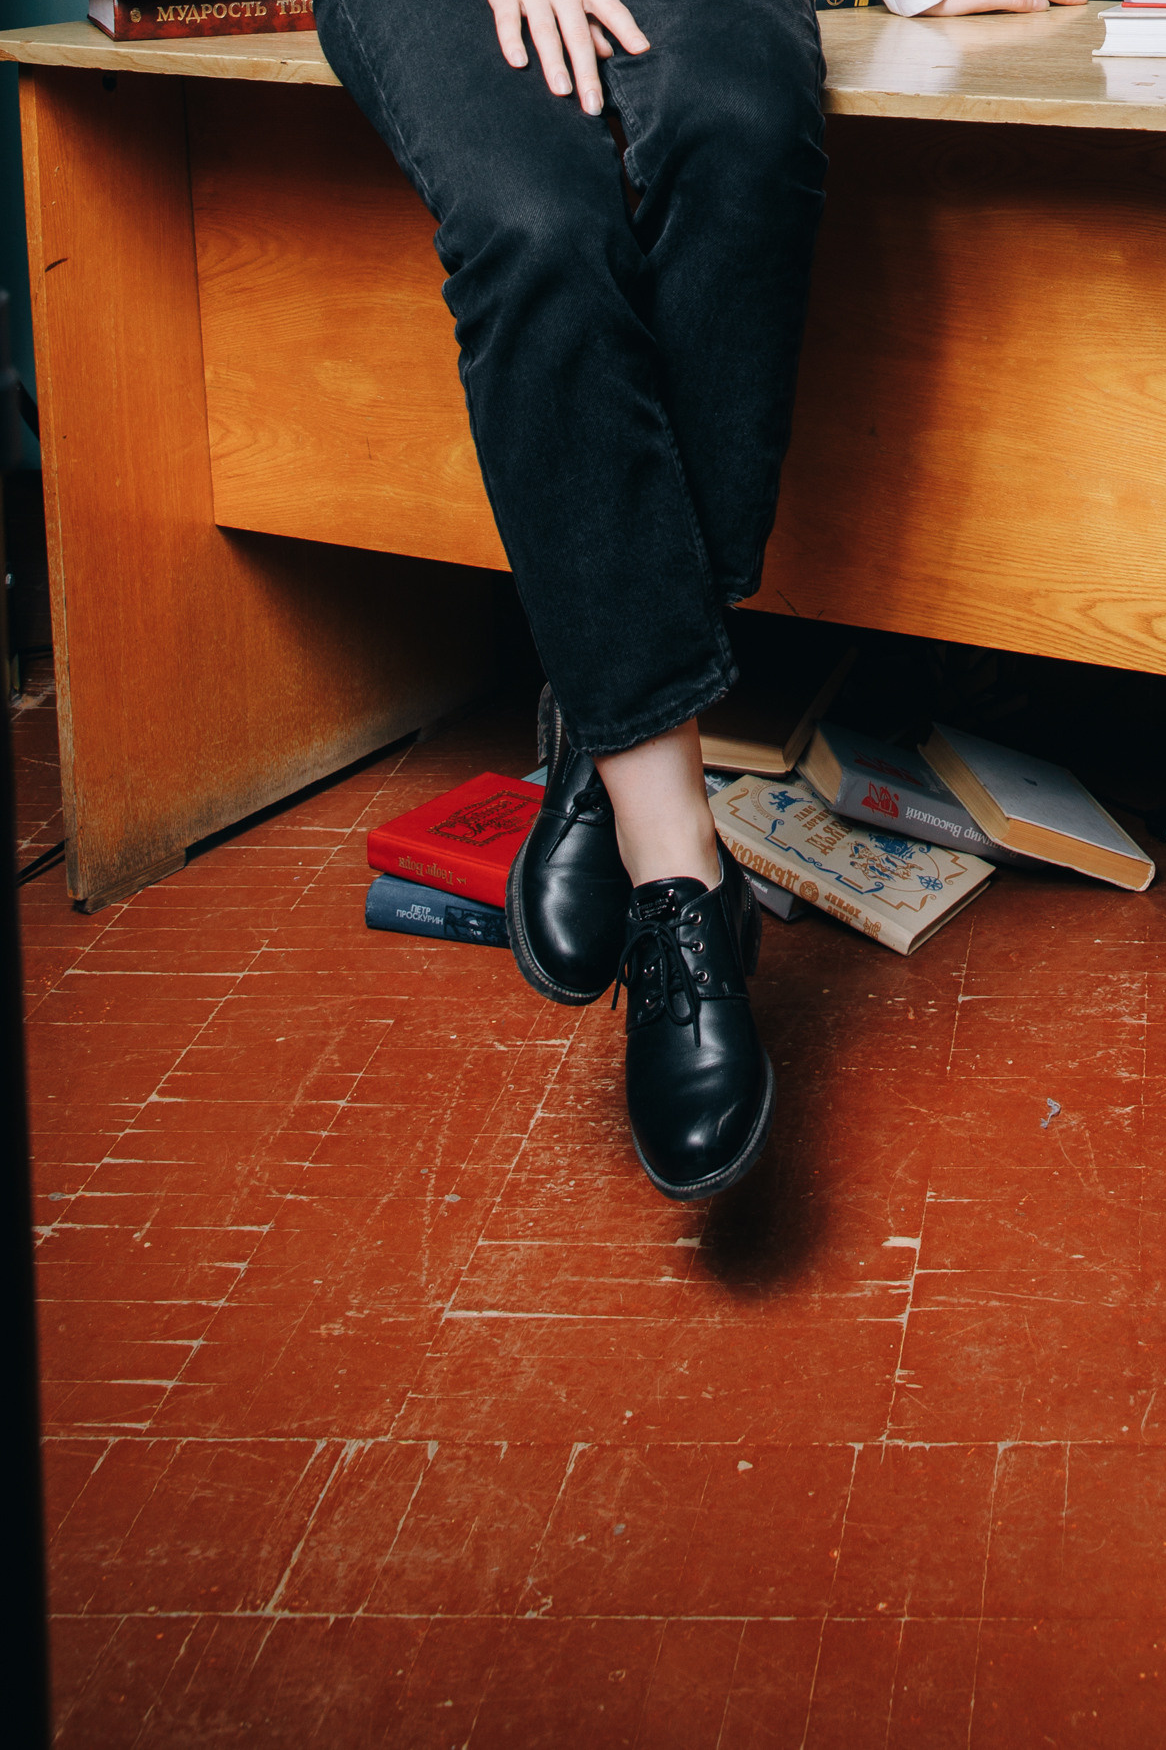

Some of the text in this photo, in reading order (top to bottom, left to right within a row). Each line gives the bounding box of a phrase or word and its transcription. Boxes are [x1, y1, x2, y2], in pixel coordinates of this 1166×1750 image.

[156, 0, 268, 24] МУДРОСТЬ
[905, 806, 962, 838] Высоцкий
[804, 820, 854, 855] ДЬЯВ
[396, 909, 444, 925] ПРОСКУРИН
[411, 904, 431, 913] ПЕТР
[824, 892, 862, 918] ХОРНЕР
